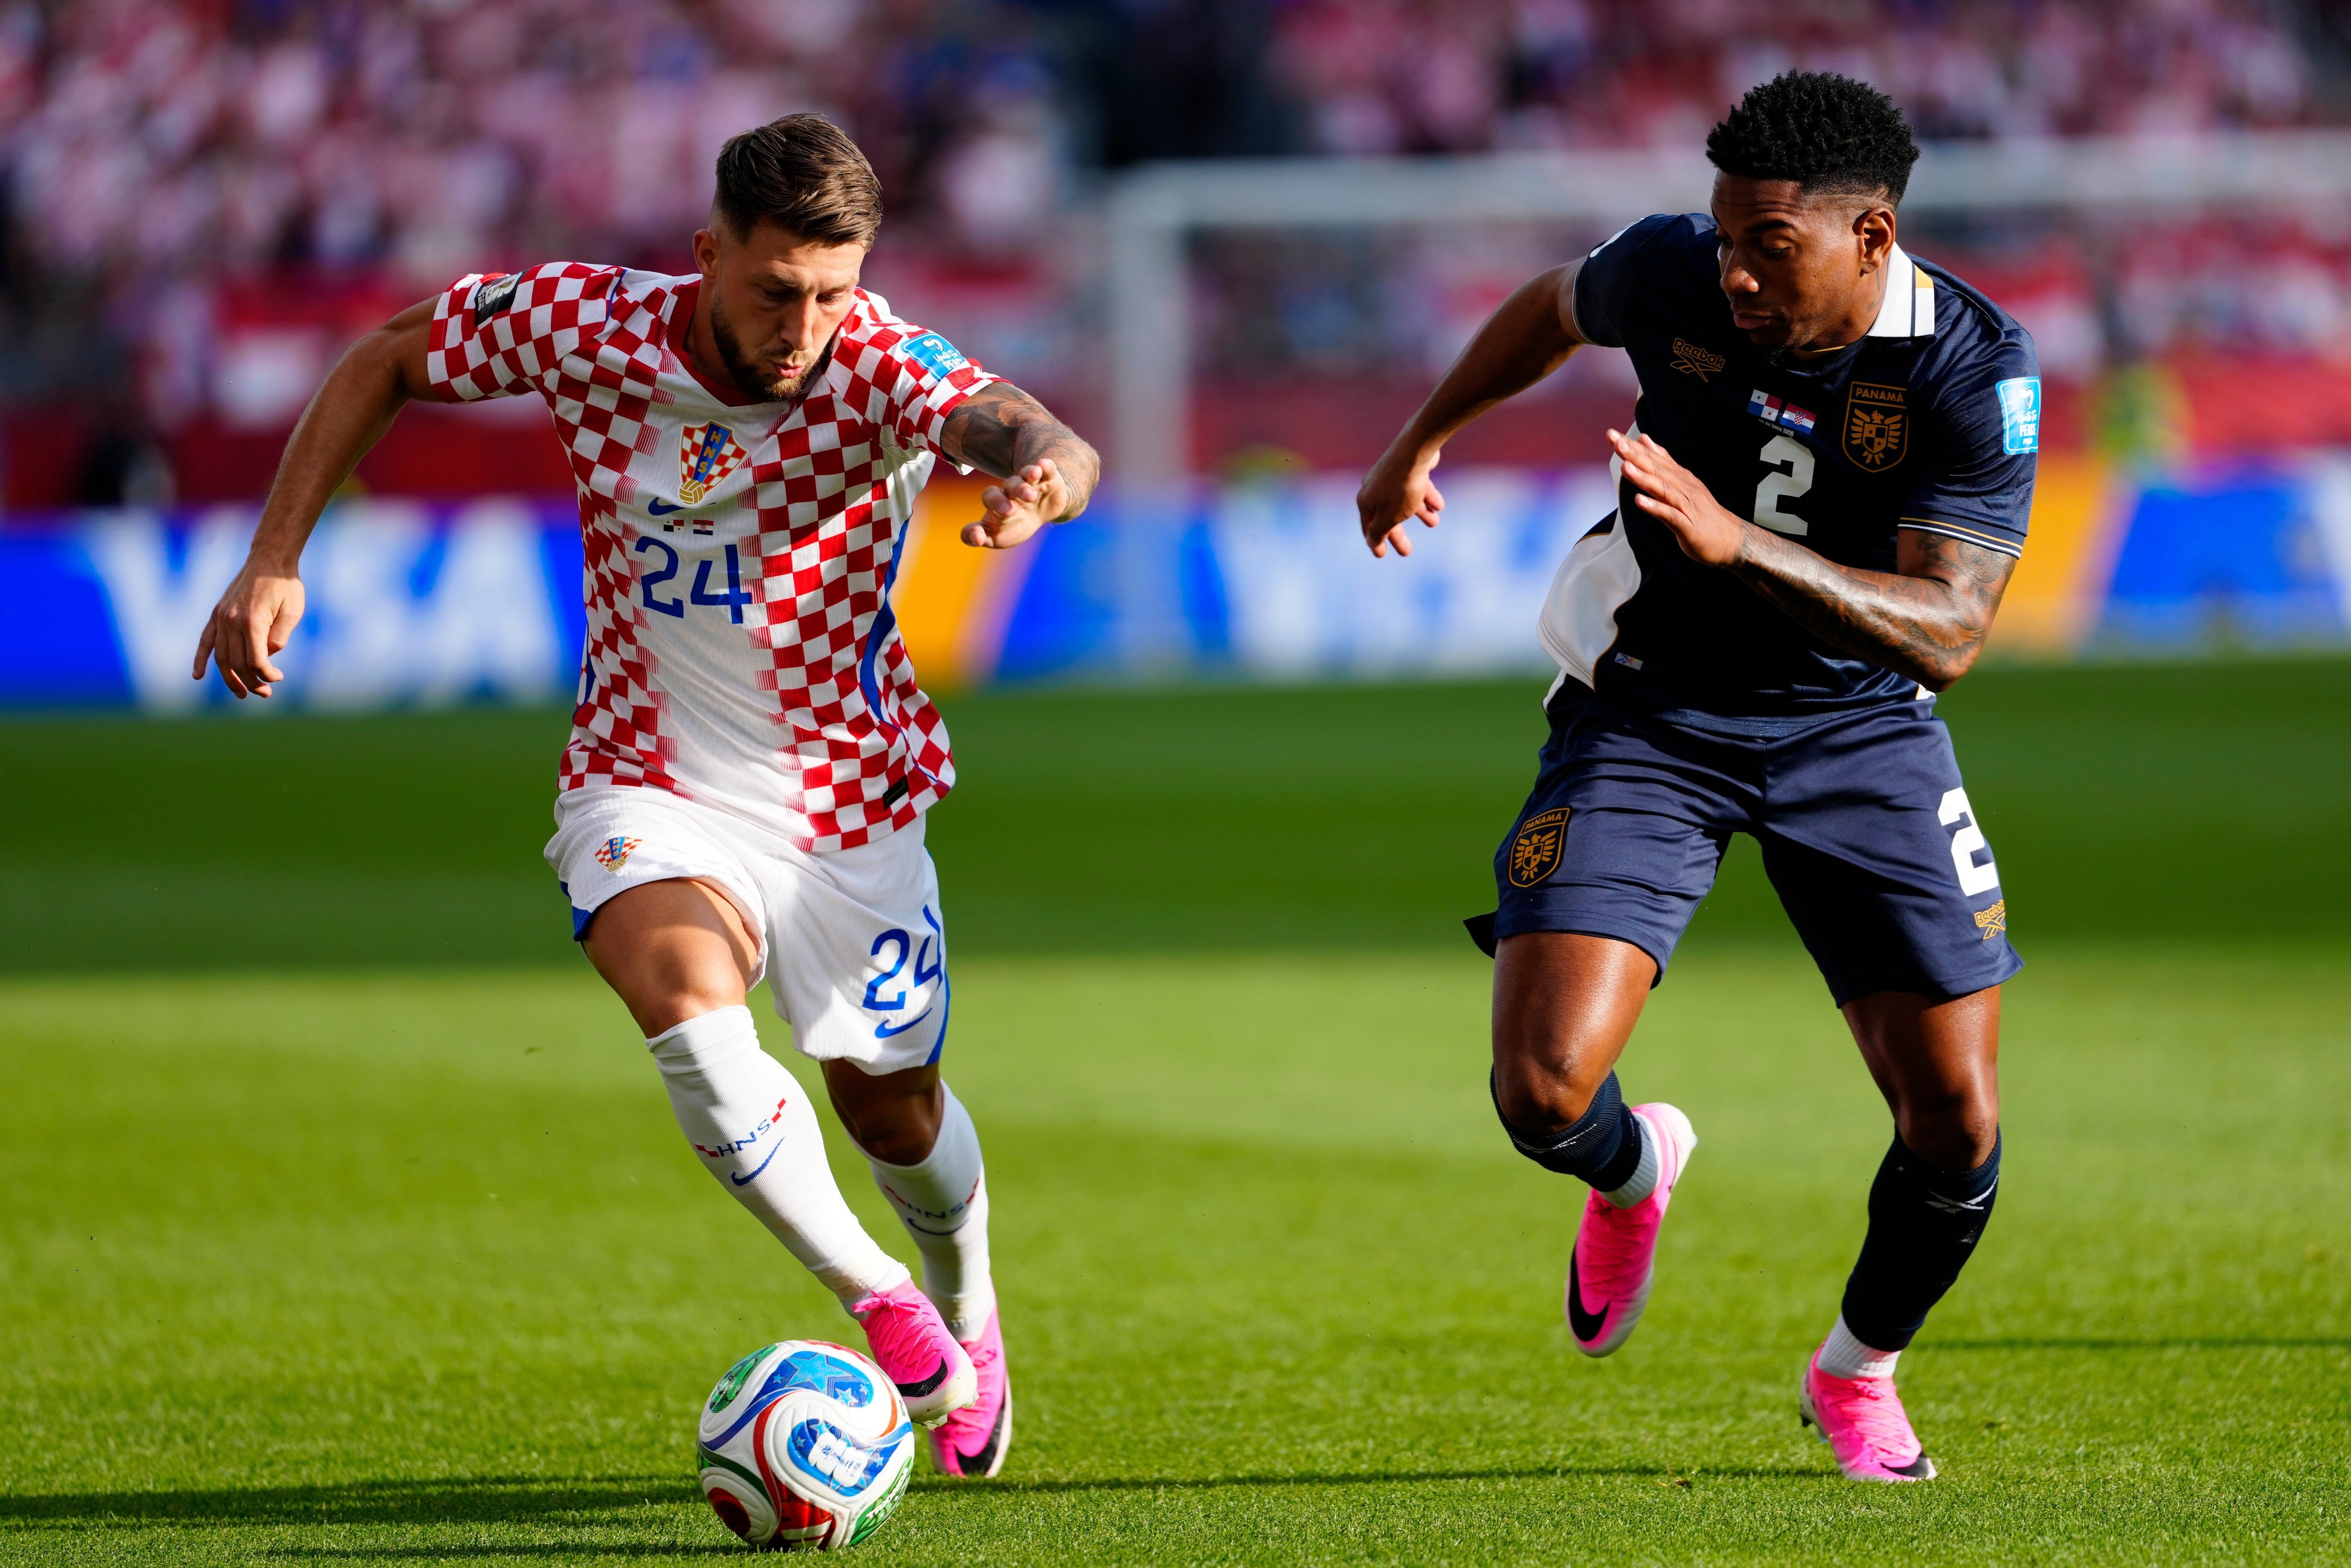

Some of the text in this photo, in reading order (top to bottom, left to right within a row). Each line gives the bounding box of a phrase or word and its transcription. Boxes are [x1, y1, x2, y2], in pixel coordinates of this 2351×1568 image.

[1673, 338, 1726, 369] Reebok
[1855, 387, 1904, 403] PANAMÁ
[1783, 428, 1794, 437] 2026
[2020, 423, 2036, 436] PEACE
[698, 430, 723, 473] HNS
[1753, 435, 1815, 536] 2
[635, 536, 752, 624] 24
[78, 503, 567, 708] VSA
[1524, 812, 1562, 831] PANAMÁ
[613, 838, 621, 856] HNS
[1938, 787, 1999, 897] 2
[862, 904, 943, 1011] 24
[717, 1119, 770, 1157] HNS
[907, 1202, 964, 1219] HNS
